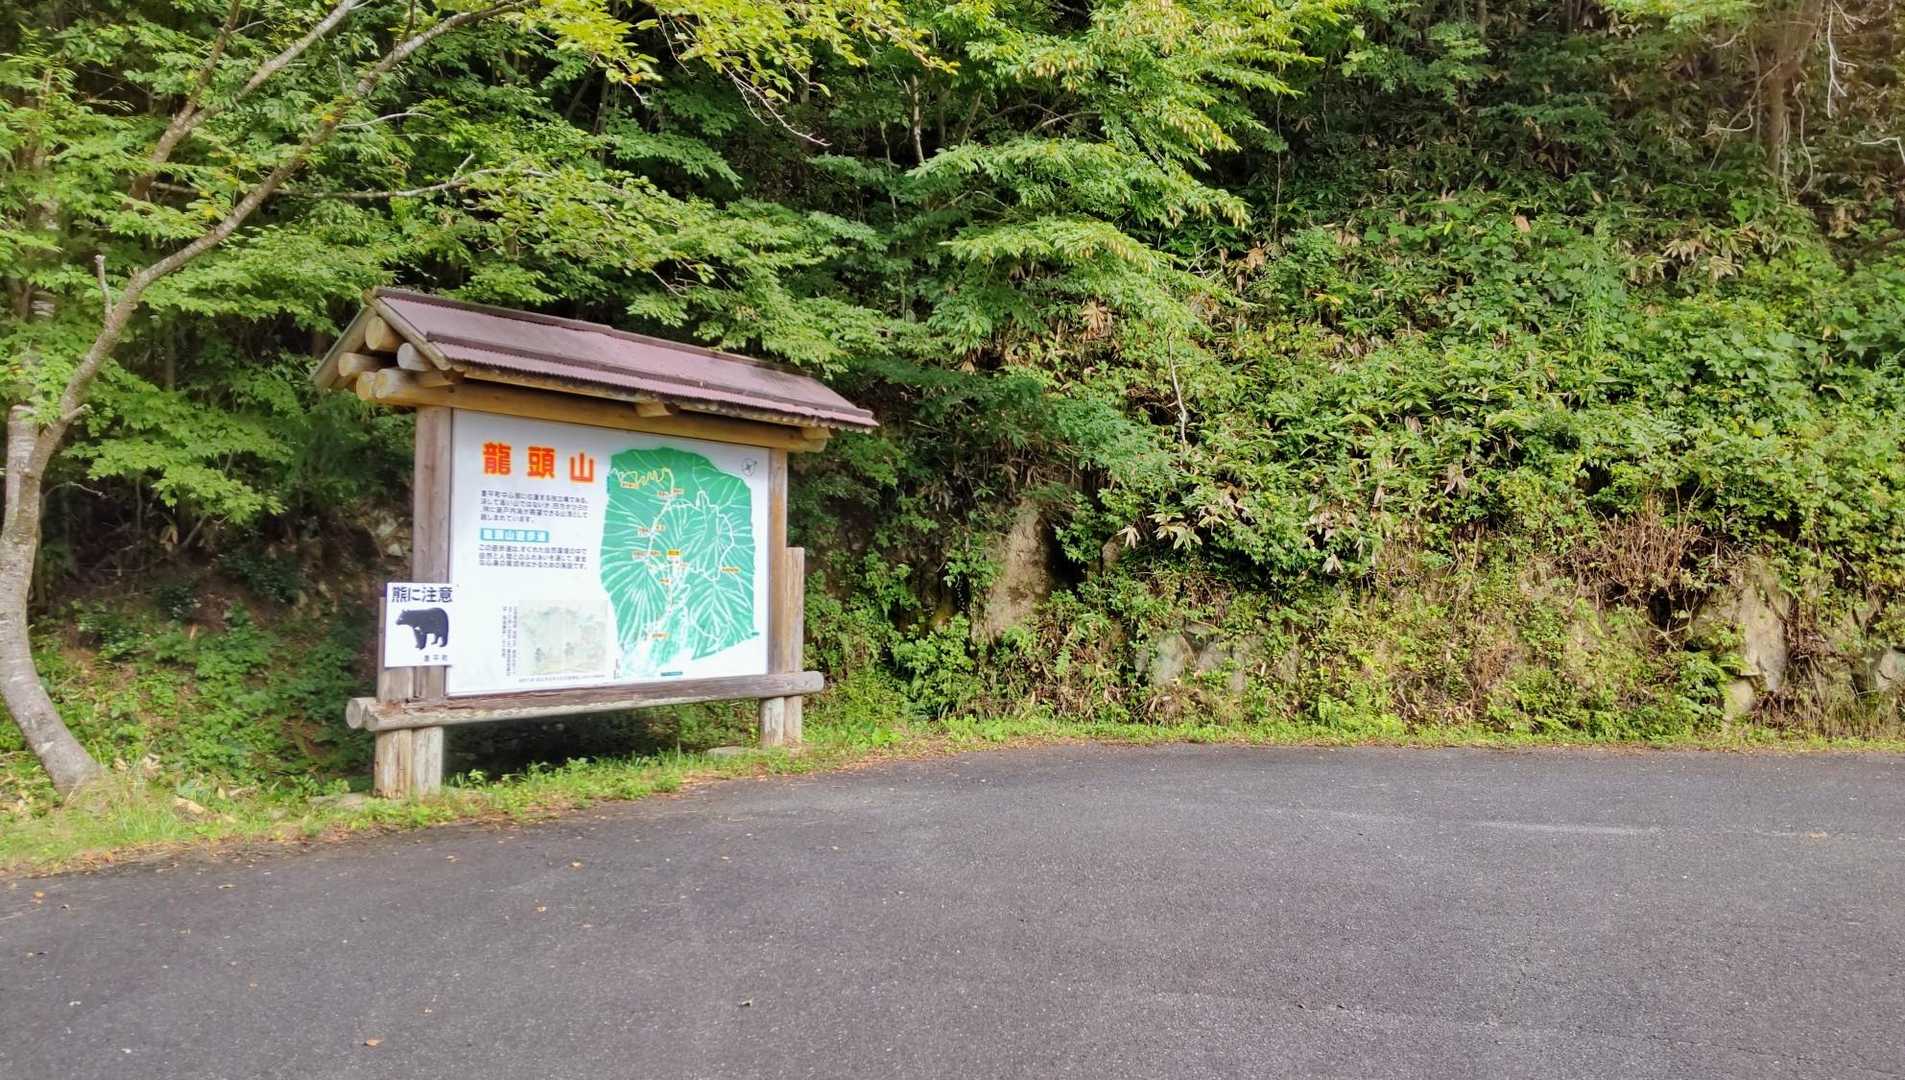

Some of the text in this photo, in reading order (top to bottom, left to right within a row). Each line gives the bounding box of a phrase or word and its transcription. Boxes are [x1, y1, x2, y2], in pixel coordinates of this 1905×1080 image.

[482, 442, 595, 484] 龍頭山
[392, 587, 452, 603] 熊に注意
